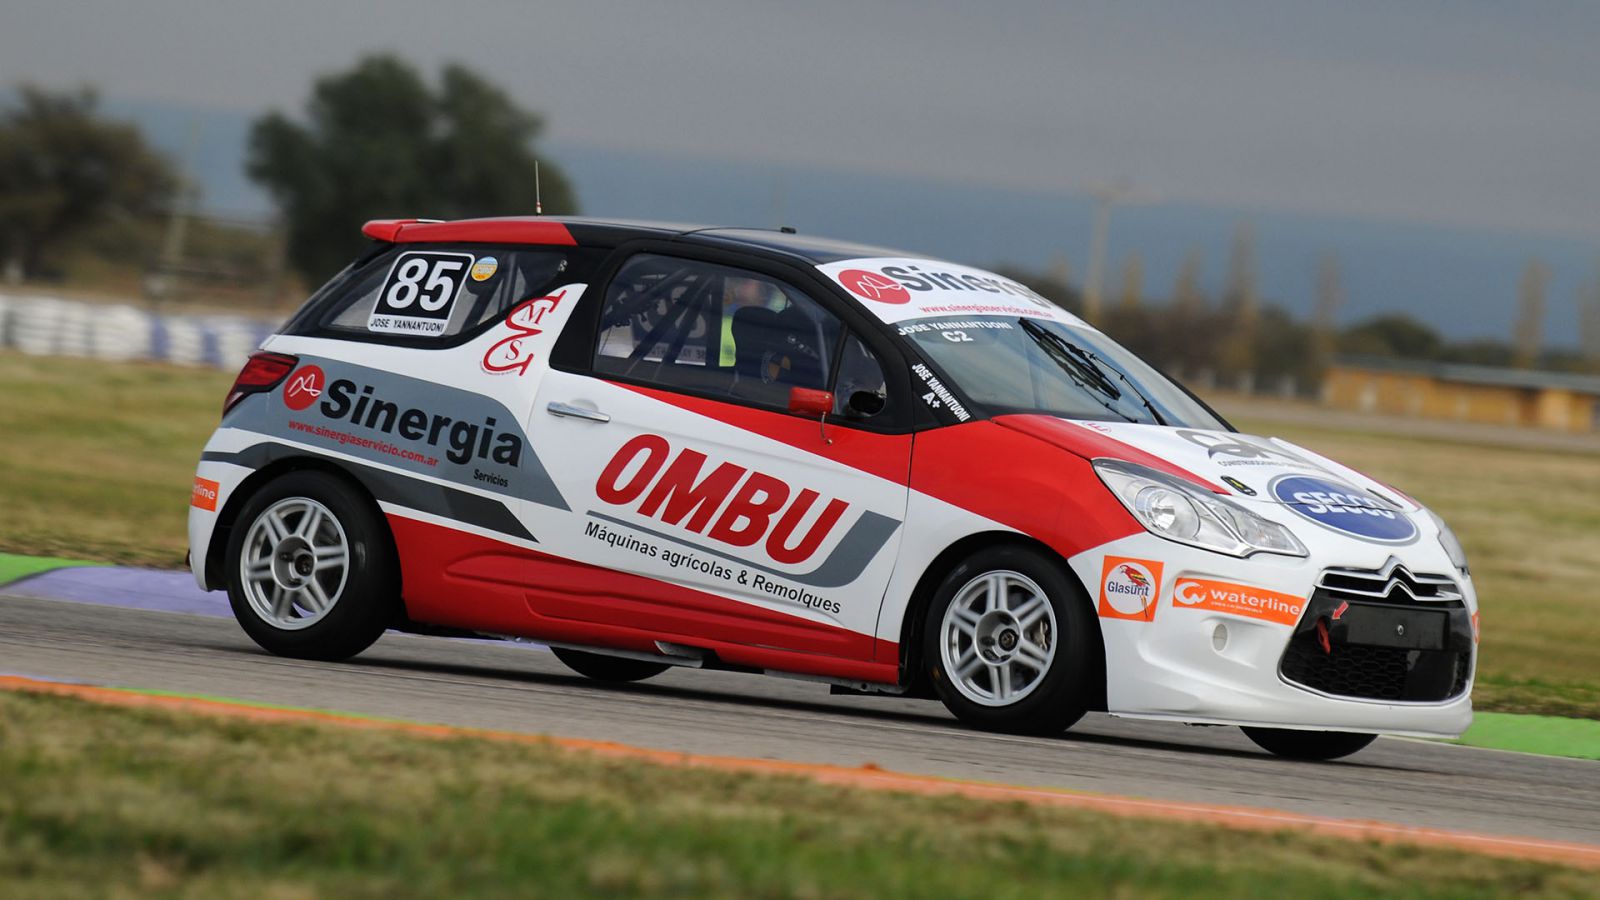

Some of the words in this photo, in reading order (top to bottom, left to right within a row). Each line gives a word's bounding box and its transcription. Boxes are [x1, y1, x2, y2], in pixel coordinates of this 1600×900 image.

[386, 258, 463, 311] 85
[371, 318, 390, 328] JOSE
[393, 319, 445, 332] YANNANTUONI
[898, 323, 931, 336] JOSE
[928, 321, 1014, 330] YANNANTUONI
[941, 330, 974, 342] C2
[911, 363, 933, 381] JOSE
[926, 376, 971, 422] YANNANTUONI
[922, 391, 941, 408] A+
[320, 378, 523, 468] Sinergia
[288, 419, 440, 468] www.sinergiaservicio.com.ar
[473, 468, 509, 488] Servicios
[595, 433, 850, 565] OMBU
[1293, 491, 1396, 520] SECCO
[584, 521, 658, 557] Máquinas
[661, 550, 733, 580] agrícolas
[736, 569, 749, 586] &
[752, 574, 842, 614] Remolques
[1107, 581, 1150, 597] Glasurit
[1210, 588, 1301, 615] waterline
